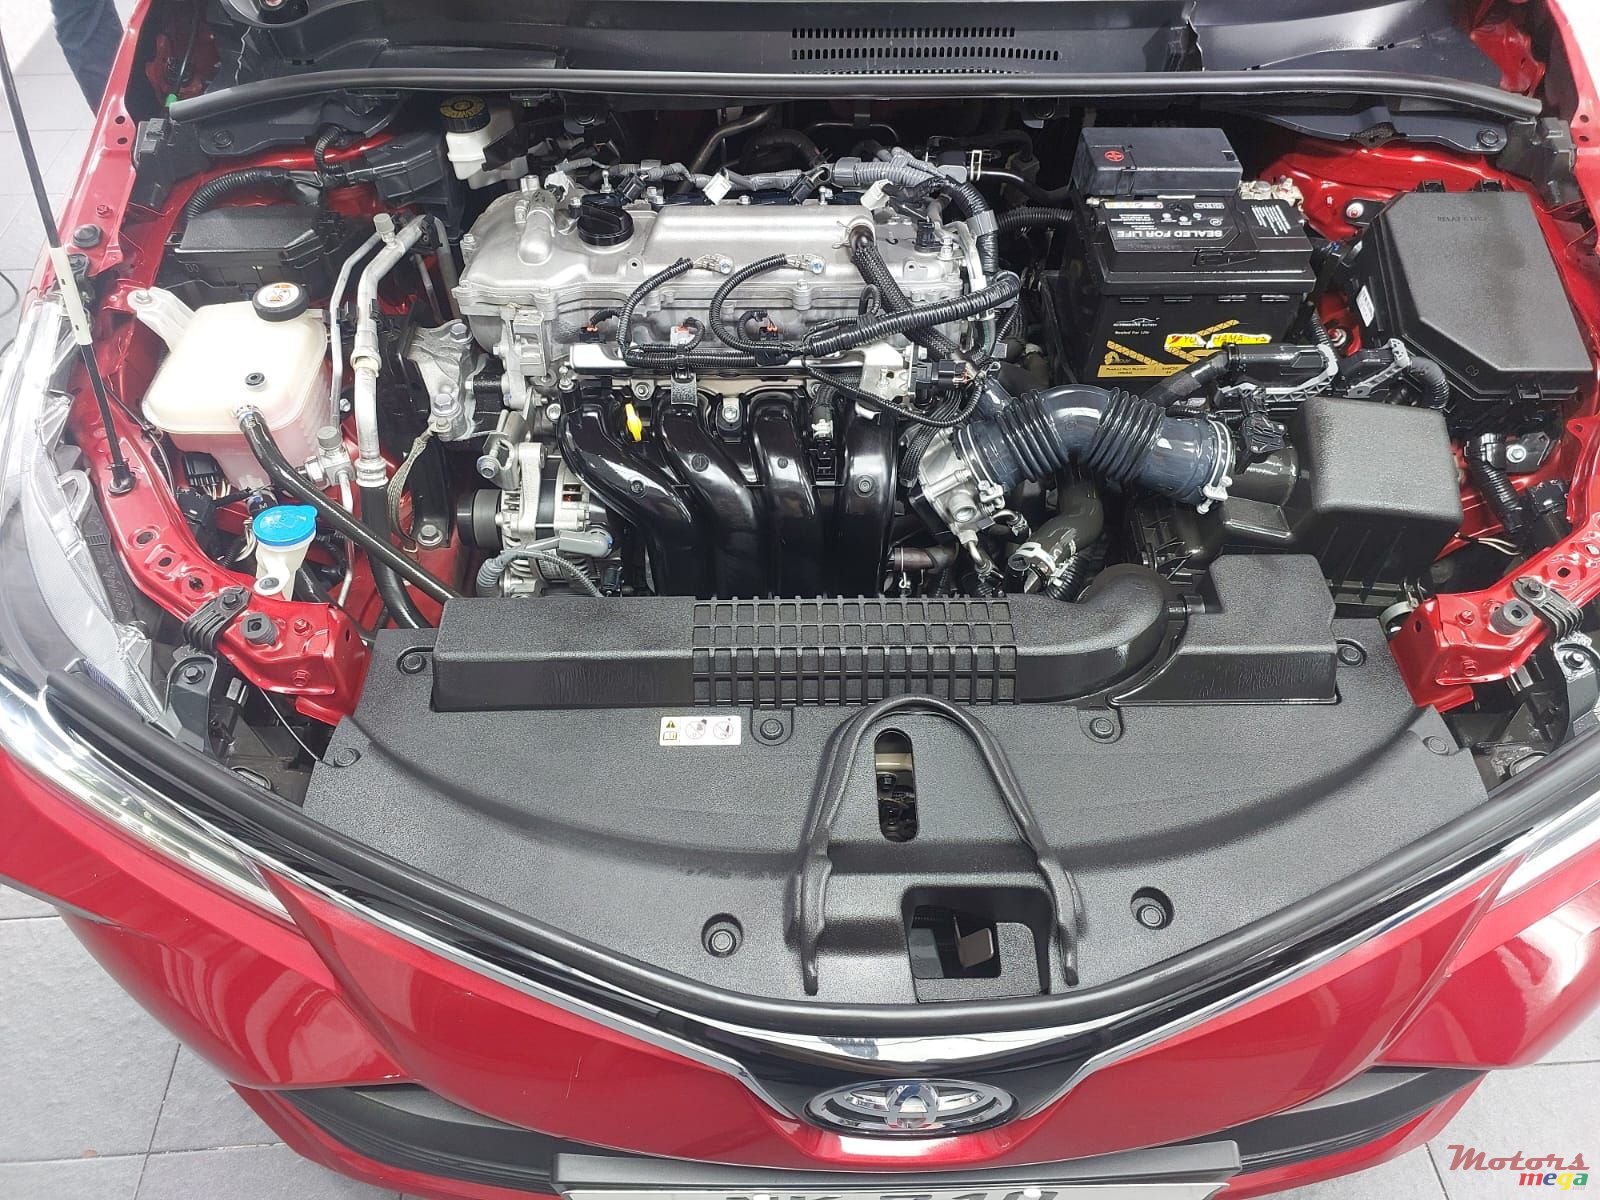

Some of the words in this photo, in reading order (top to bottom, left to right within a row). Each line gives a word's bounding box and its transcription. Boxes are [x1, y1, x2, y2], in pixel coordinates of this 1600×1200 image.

[1116, 230, 1143, 238] LIFE
[1145, 230, 1172, 238] FOR
[1173, 229, 1223, 238] SEALED
